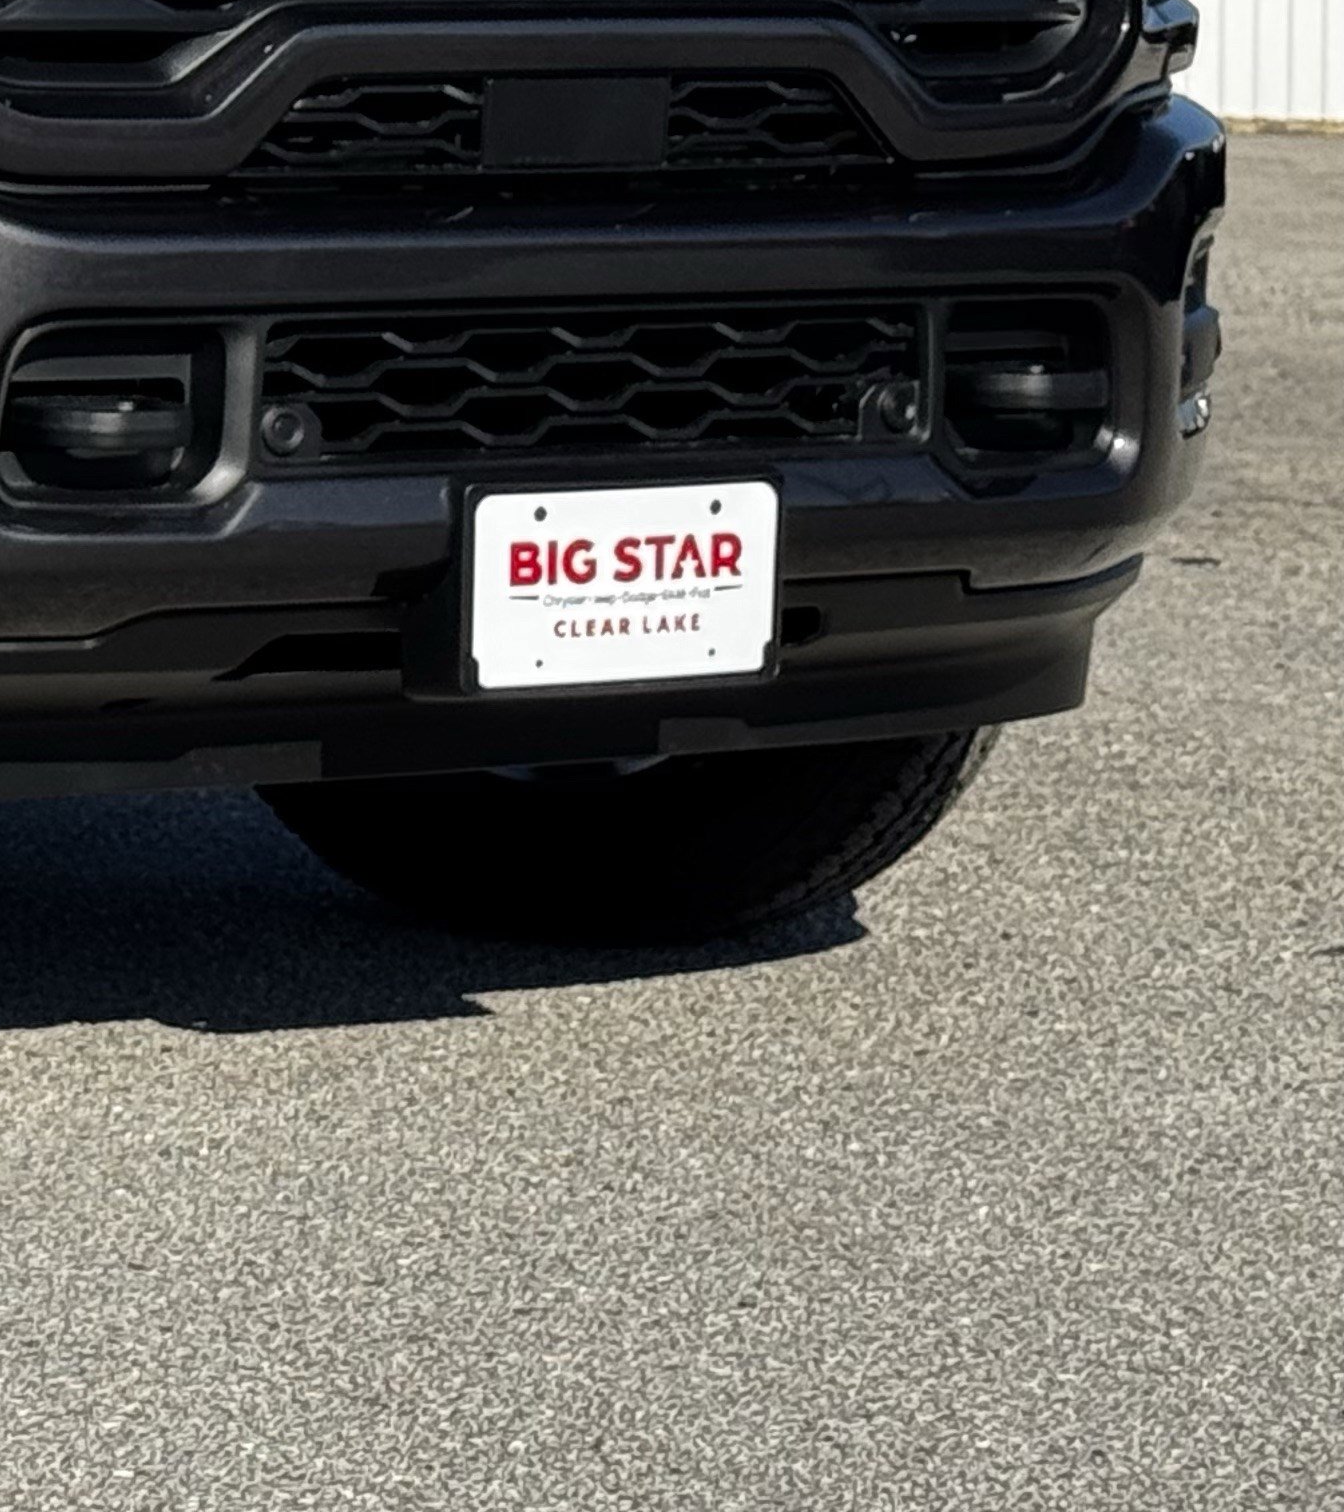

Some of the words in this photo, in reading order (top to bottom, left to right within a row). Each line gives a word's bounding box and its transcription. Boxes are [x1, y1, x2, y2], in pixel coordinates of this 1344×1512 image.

[509, 538, 597, 587] BIG
[612, 532, 743, 582] STAR
[553, 617, 631, 639] CLEAR
[643, 612, 701, 634] LAKE
